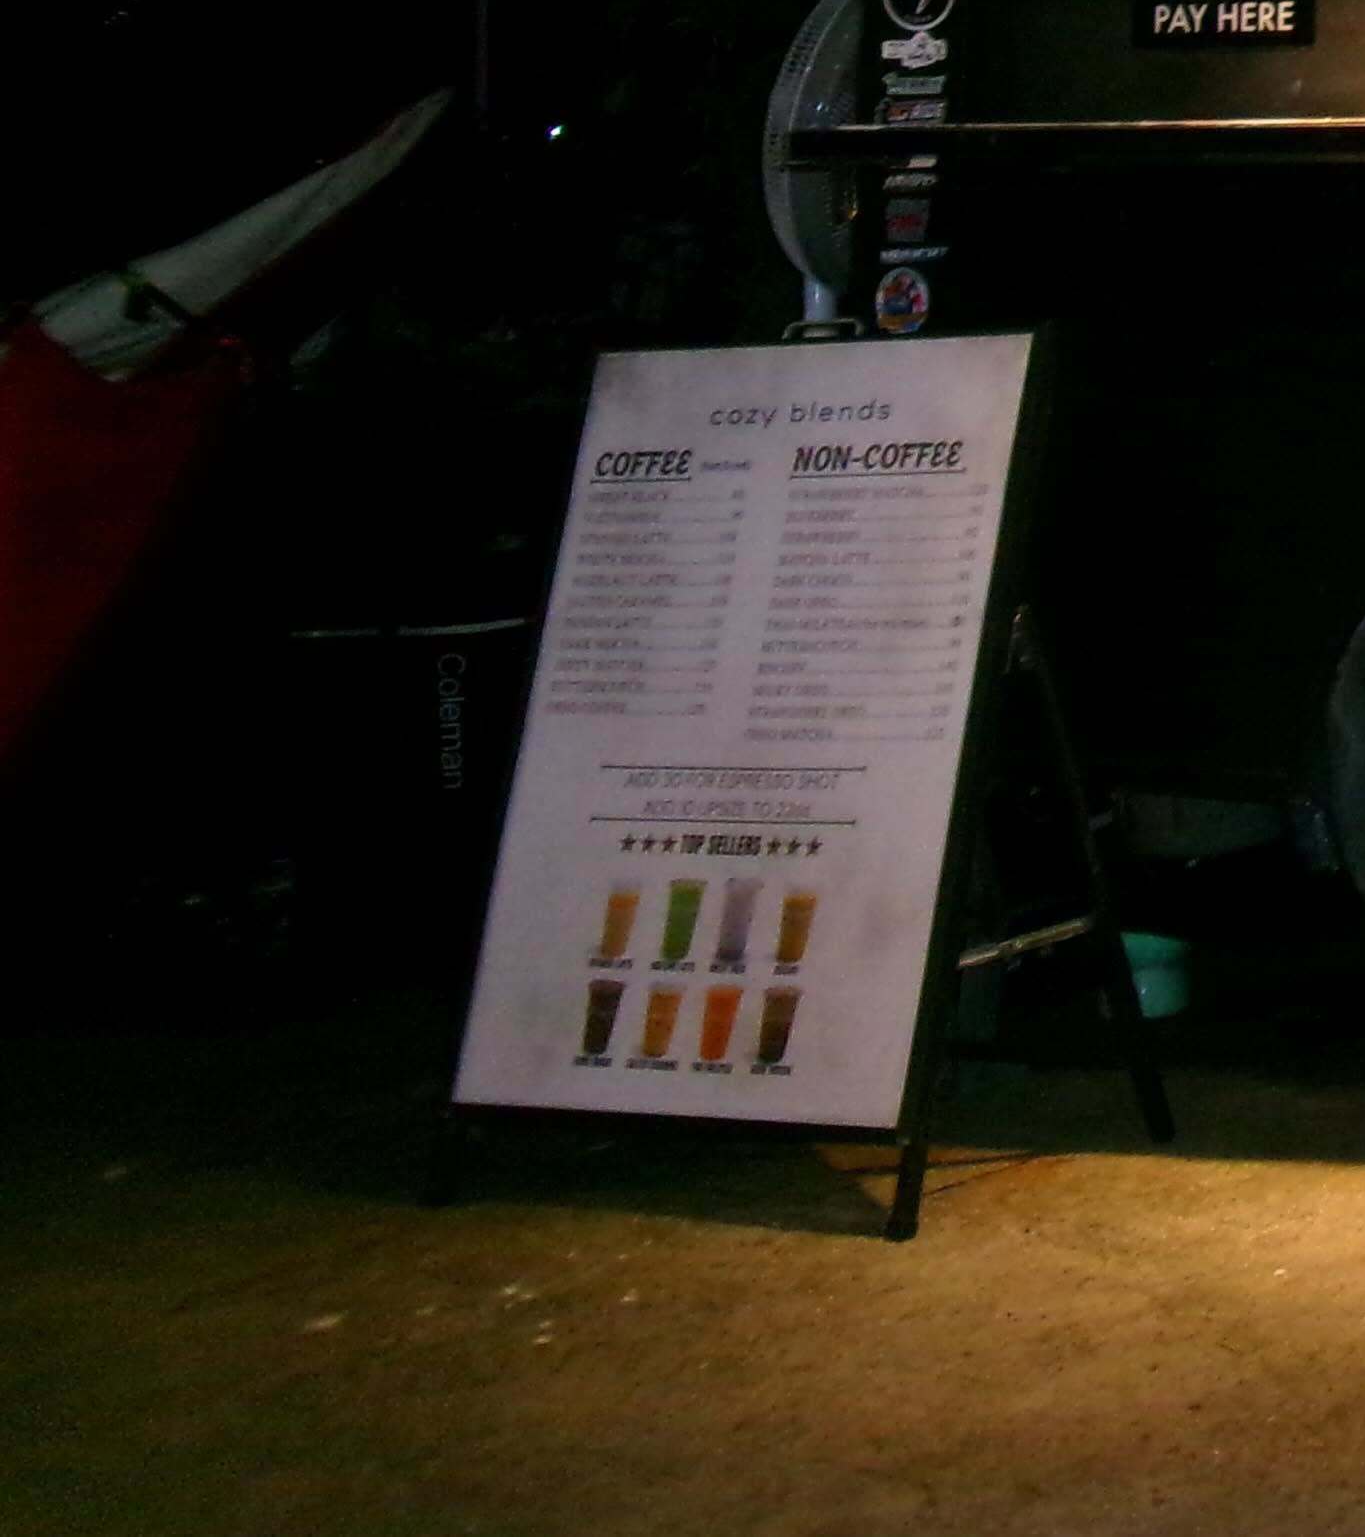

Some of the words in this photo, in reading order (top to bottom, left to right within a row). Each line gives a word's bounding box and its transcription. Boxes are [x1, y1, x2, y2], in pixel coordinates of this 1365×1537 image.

[1154, 3, 1208, 35] PAY
[1217, 0, 1295, 32] HERE
[710, 405, 777, 429] cozy
[789, 398, 891, 424] blends
[594, 448, 694, 479] COFFEE
[791, 439, 965, 473] NON-COFFEE
[437, 653, 468, 791] Coleman
